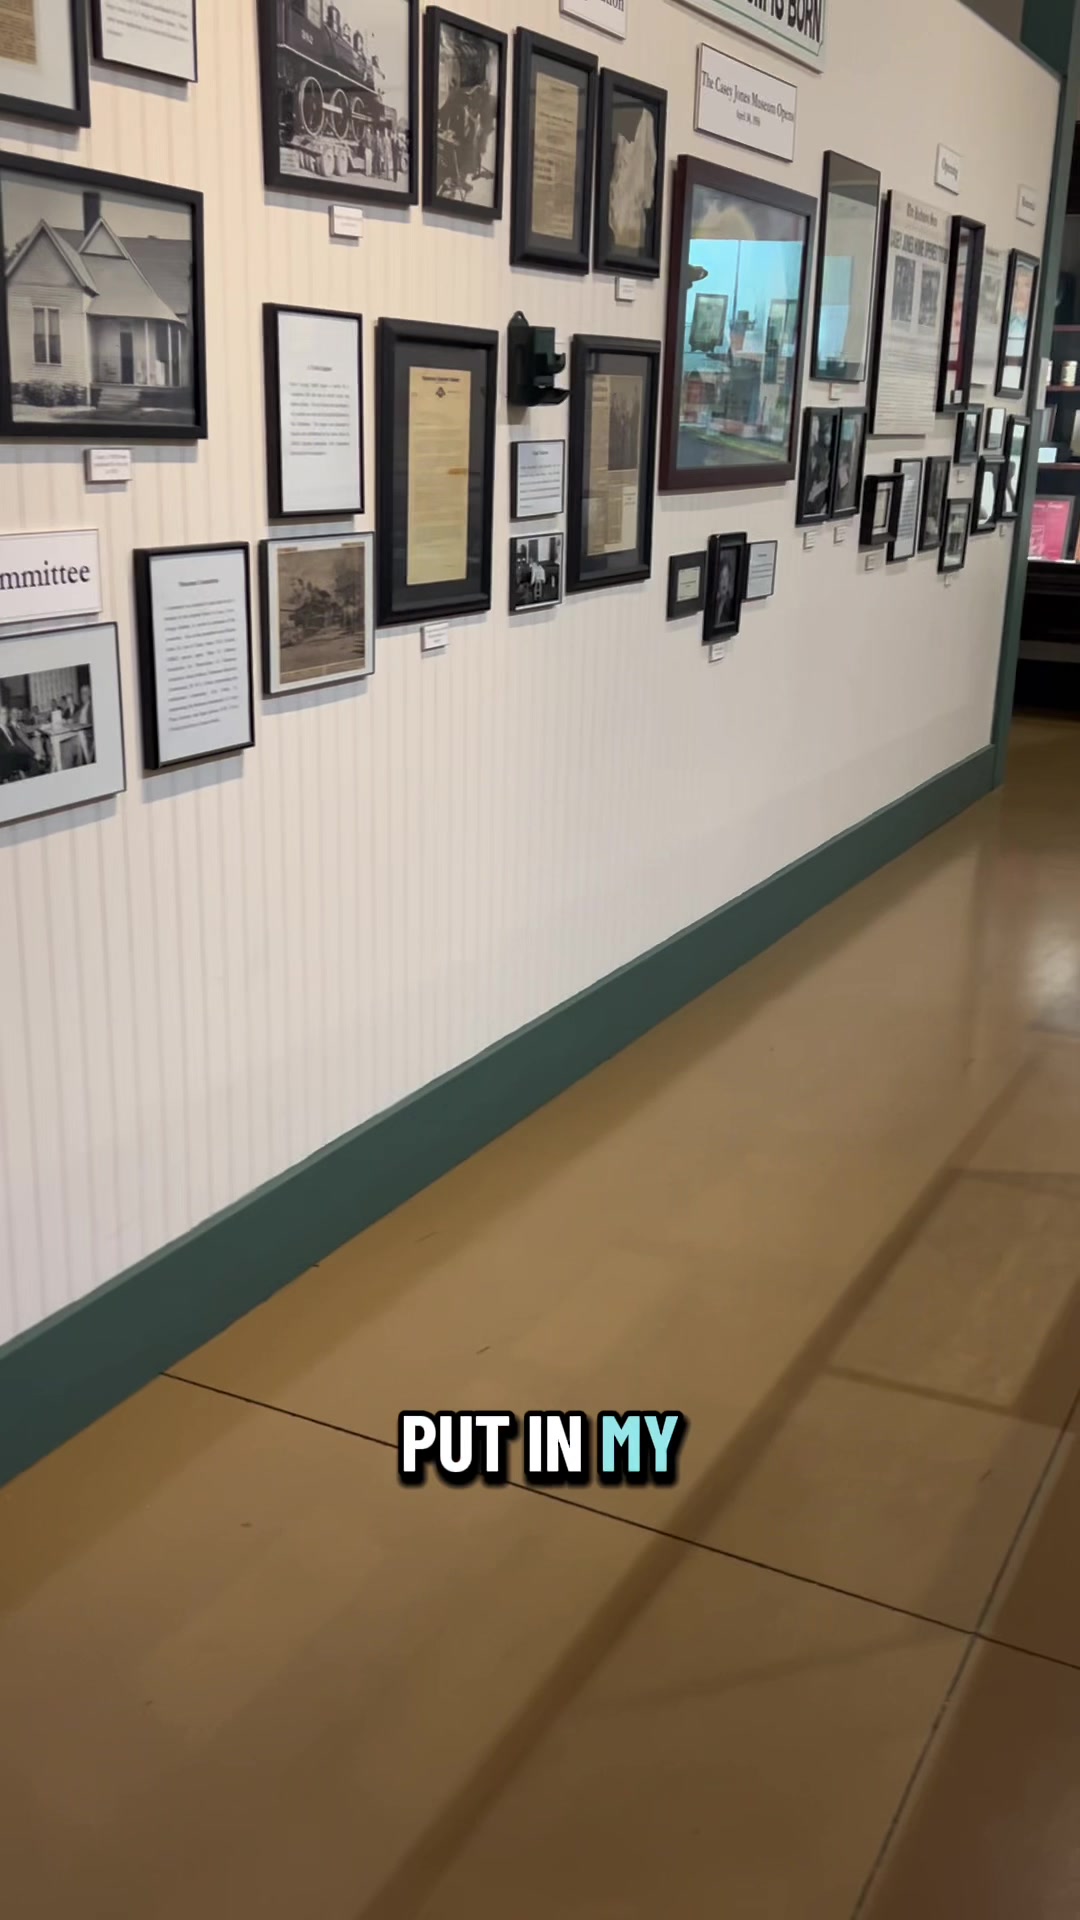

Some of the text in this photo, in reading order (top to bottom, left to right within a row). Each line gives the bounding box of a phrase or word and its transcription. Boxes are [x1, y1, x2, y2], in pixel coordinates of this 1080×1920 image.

[701, 70, 795, 123] The Casey Jones Museum Opens
